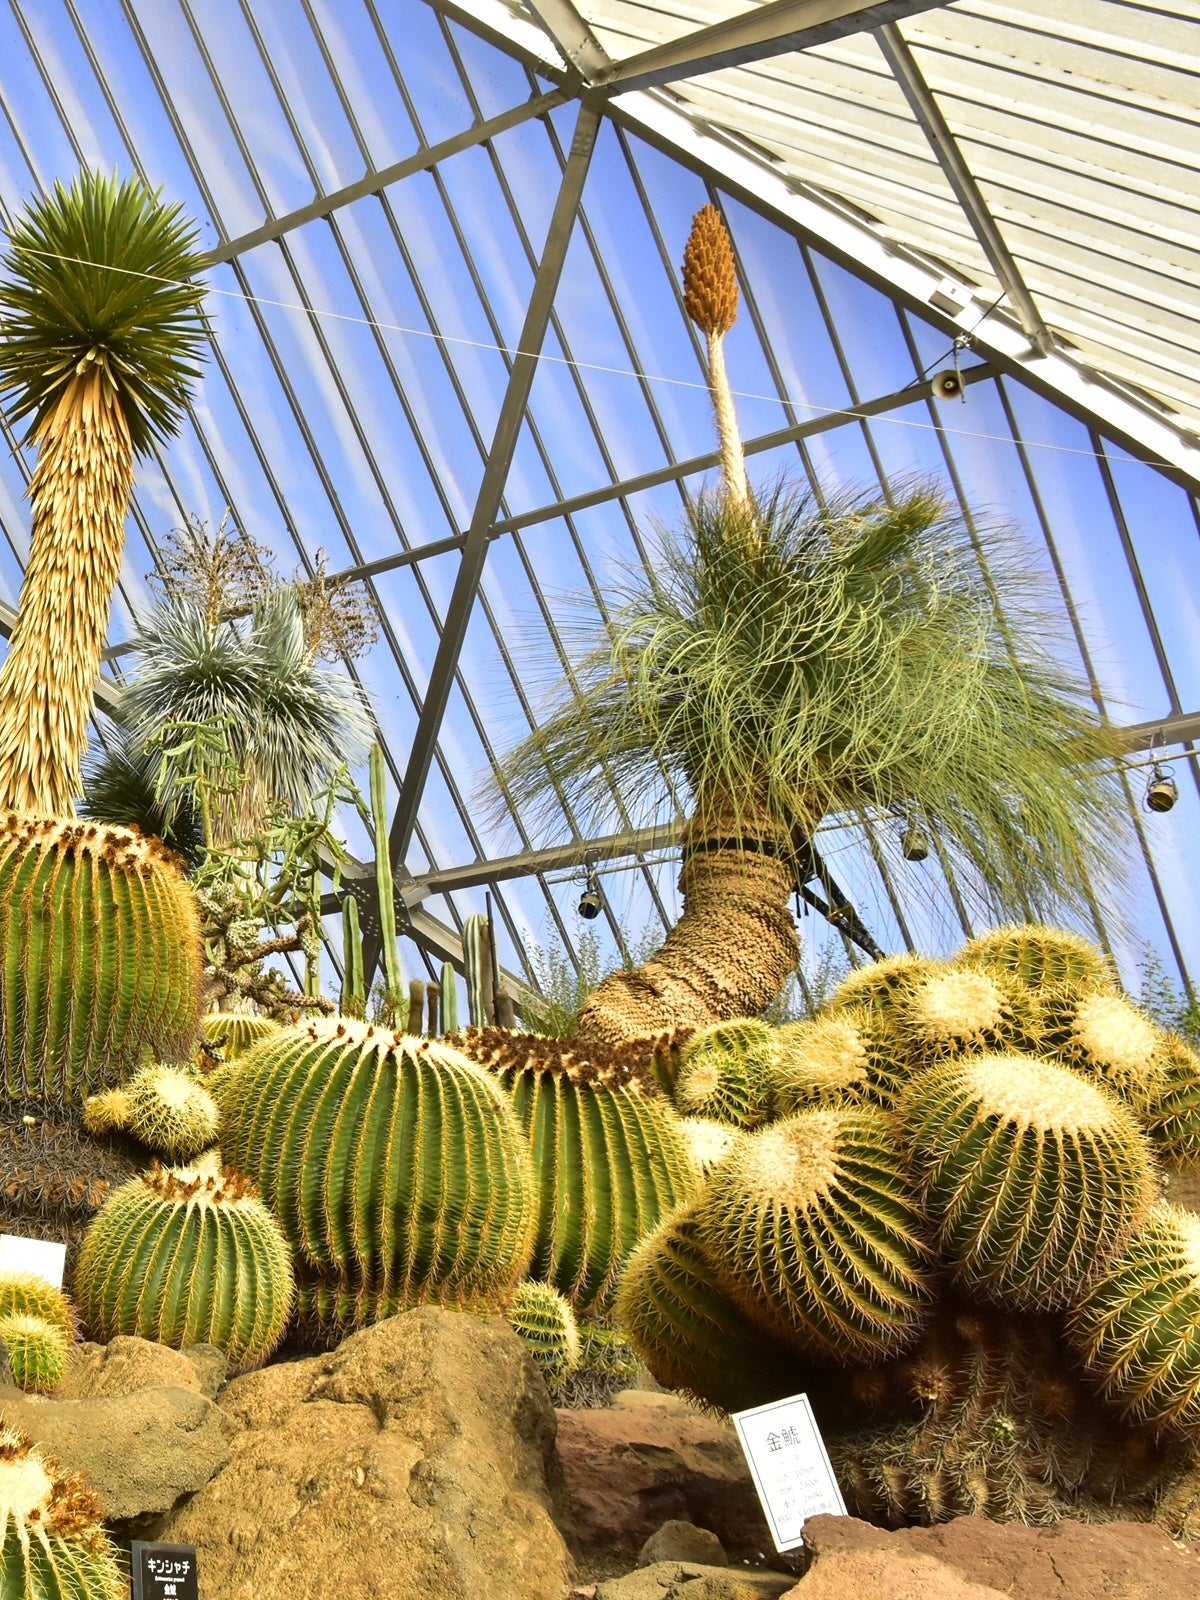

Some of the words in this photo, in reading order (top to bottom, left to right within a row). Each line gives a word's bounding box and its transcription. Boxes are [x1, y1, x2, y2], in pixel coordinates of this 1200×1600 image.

[148, 1558, 190, 1575] キンシャチ
